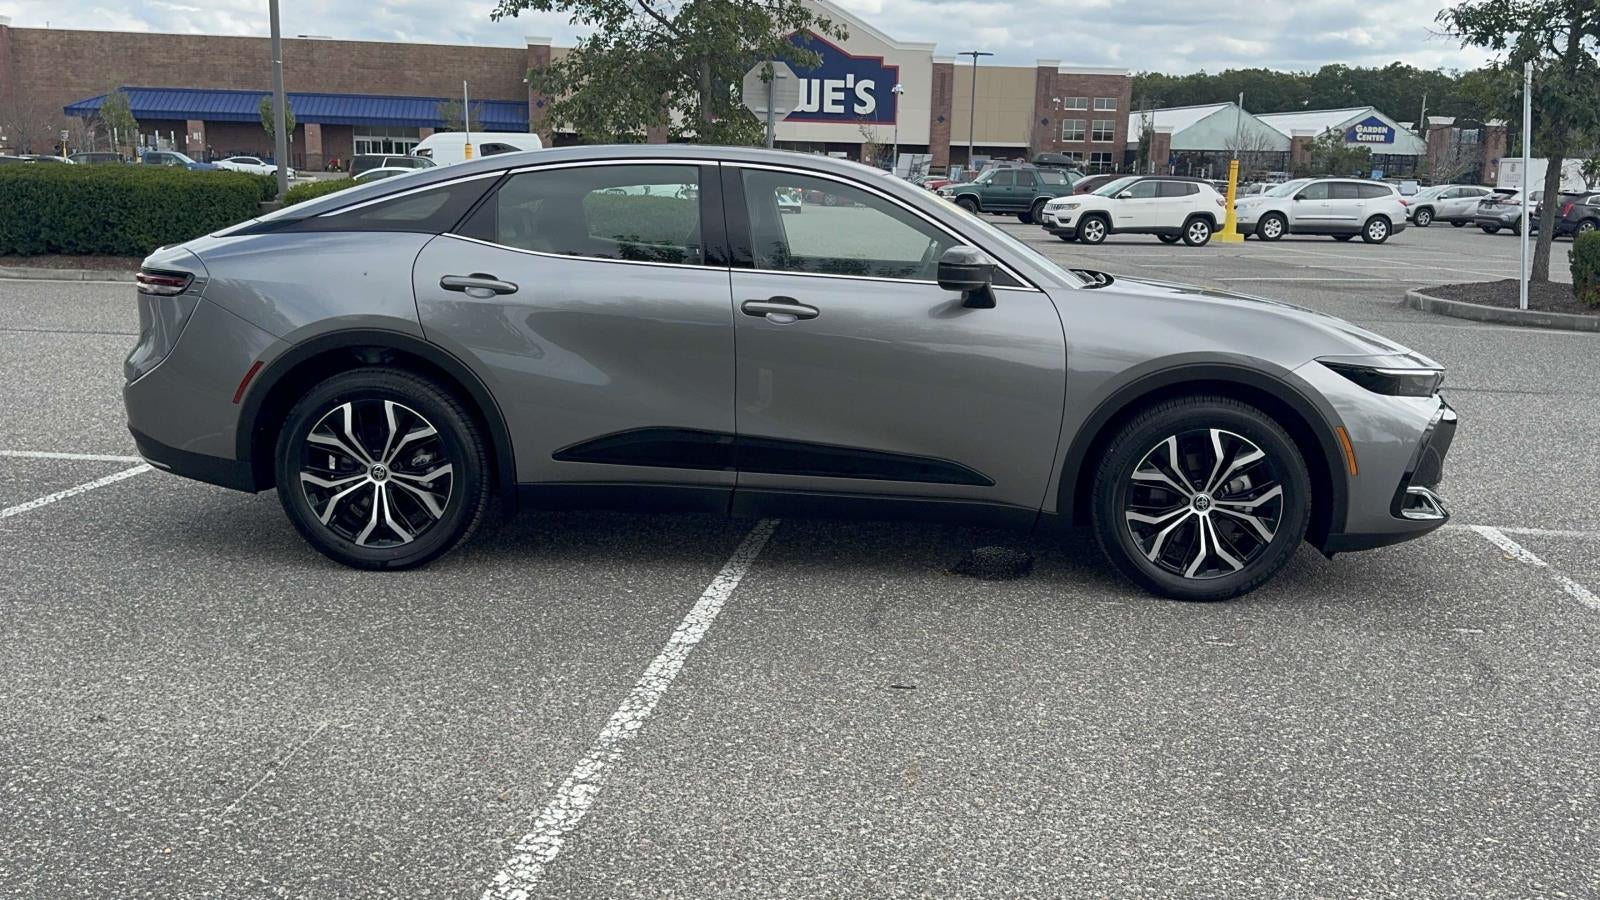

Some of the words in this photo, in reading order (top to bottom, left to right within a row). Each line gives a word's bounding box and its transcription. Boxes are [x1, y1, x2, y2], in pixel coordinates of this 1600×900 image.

[794, 74, 876, 115] WE'S
[1355, 124, 1388, 134] GARDEN
[1356, 132, 1386, 142] CENTER
